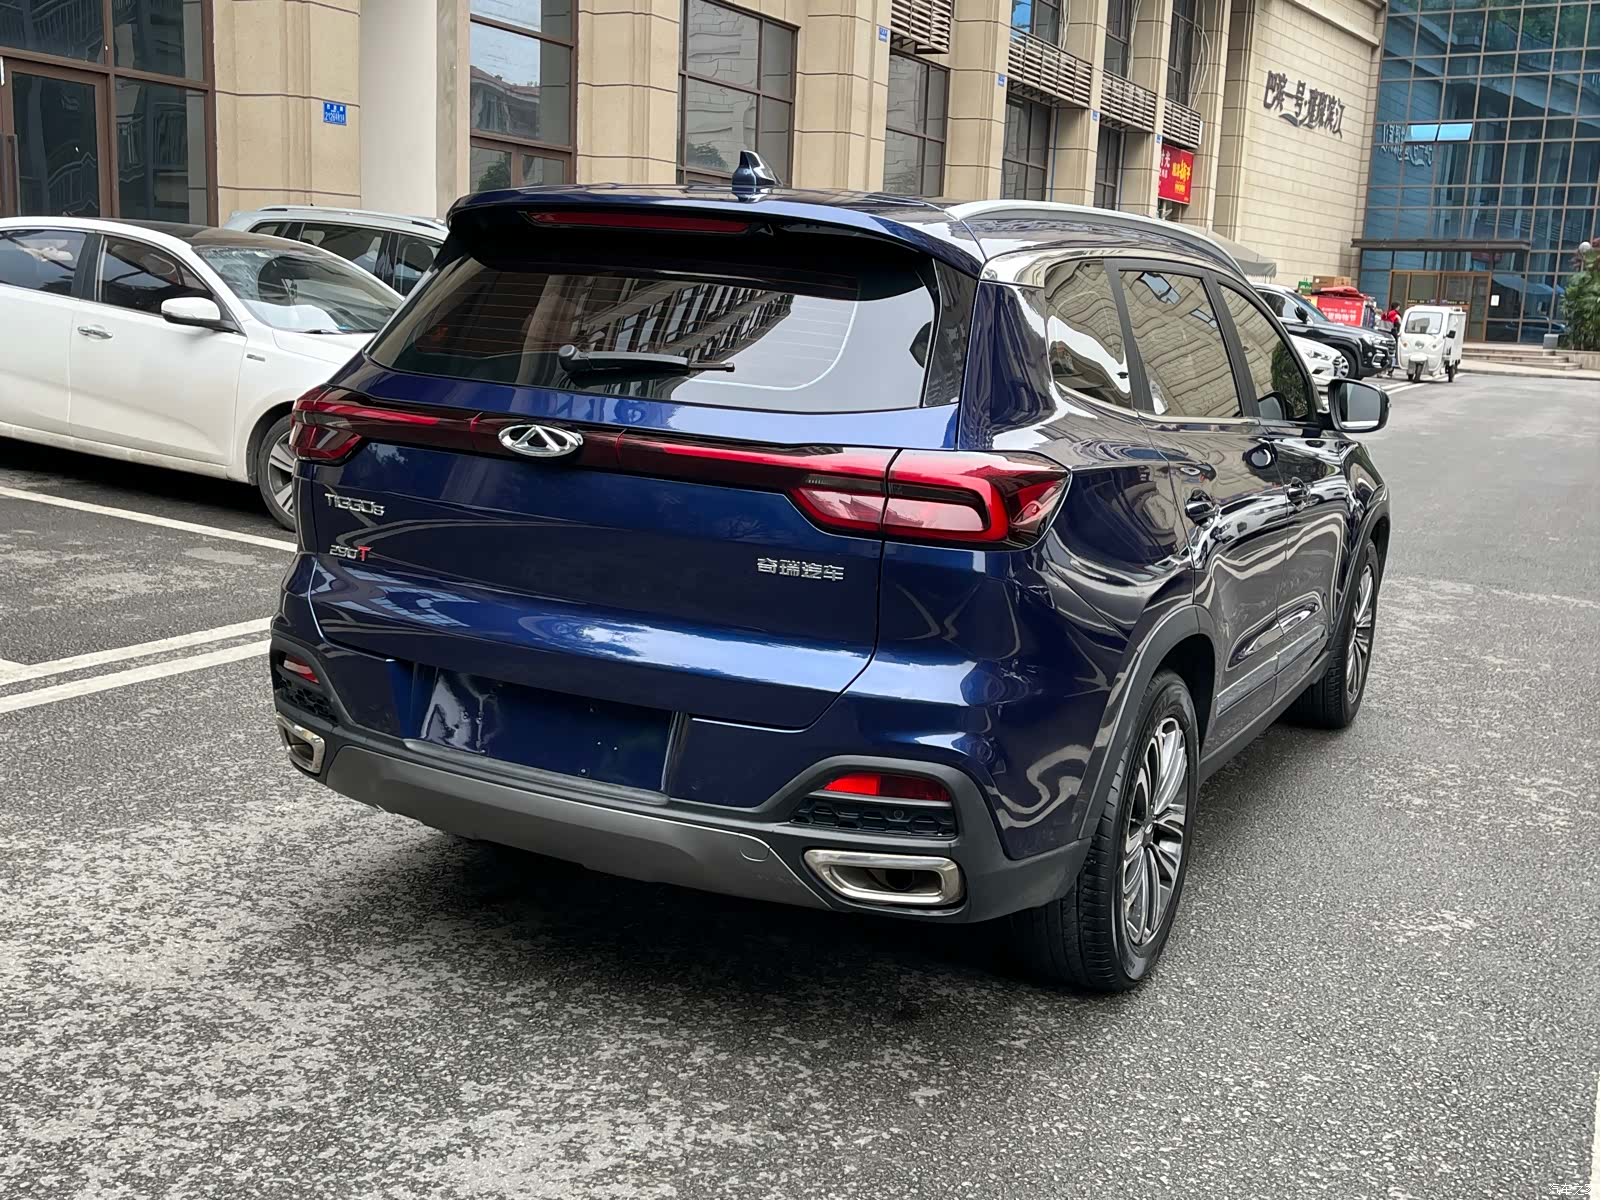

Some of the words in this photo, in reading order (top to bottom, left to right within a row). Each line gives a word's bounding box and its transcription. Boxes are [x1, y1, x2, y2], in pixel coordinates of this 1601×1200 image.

[329, 544, 374, 562] 290T
[757, 558, 845, 581] 奇瑞汽车
